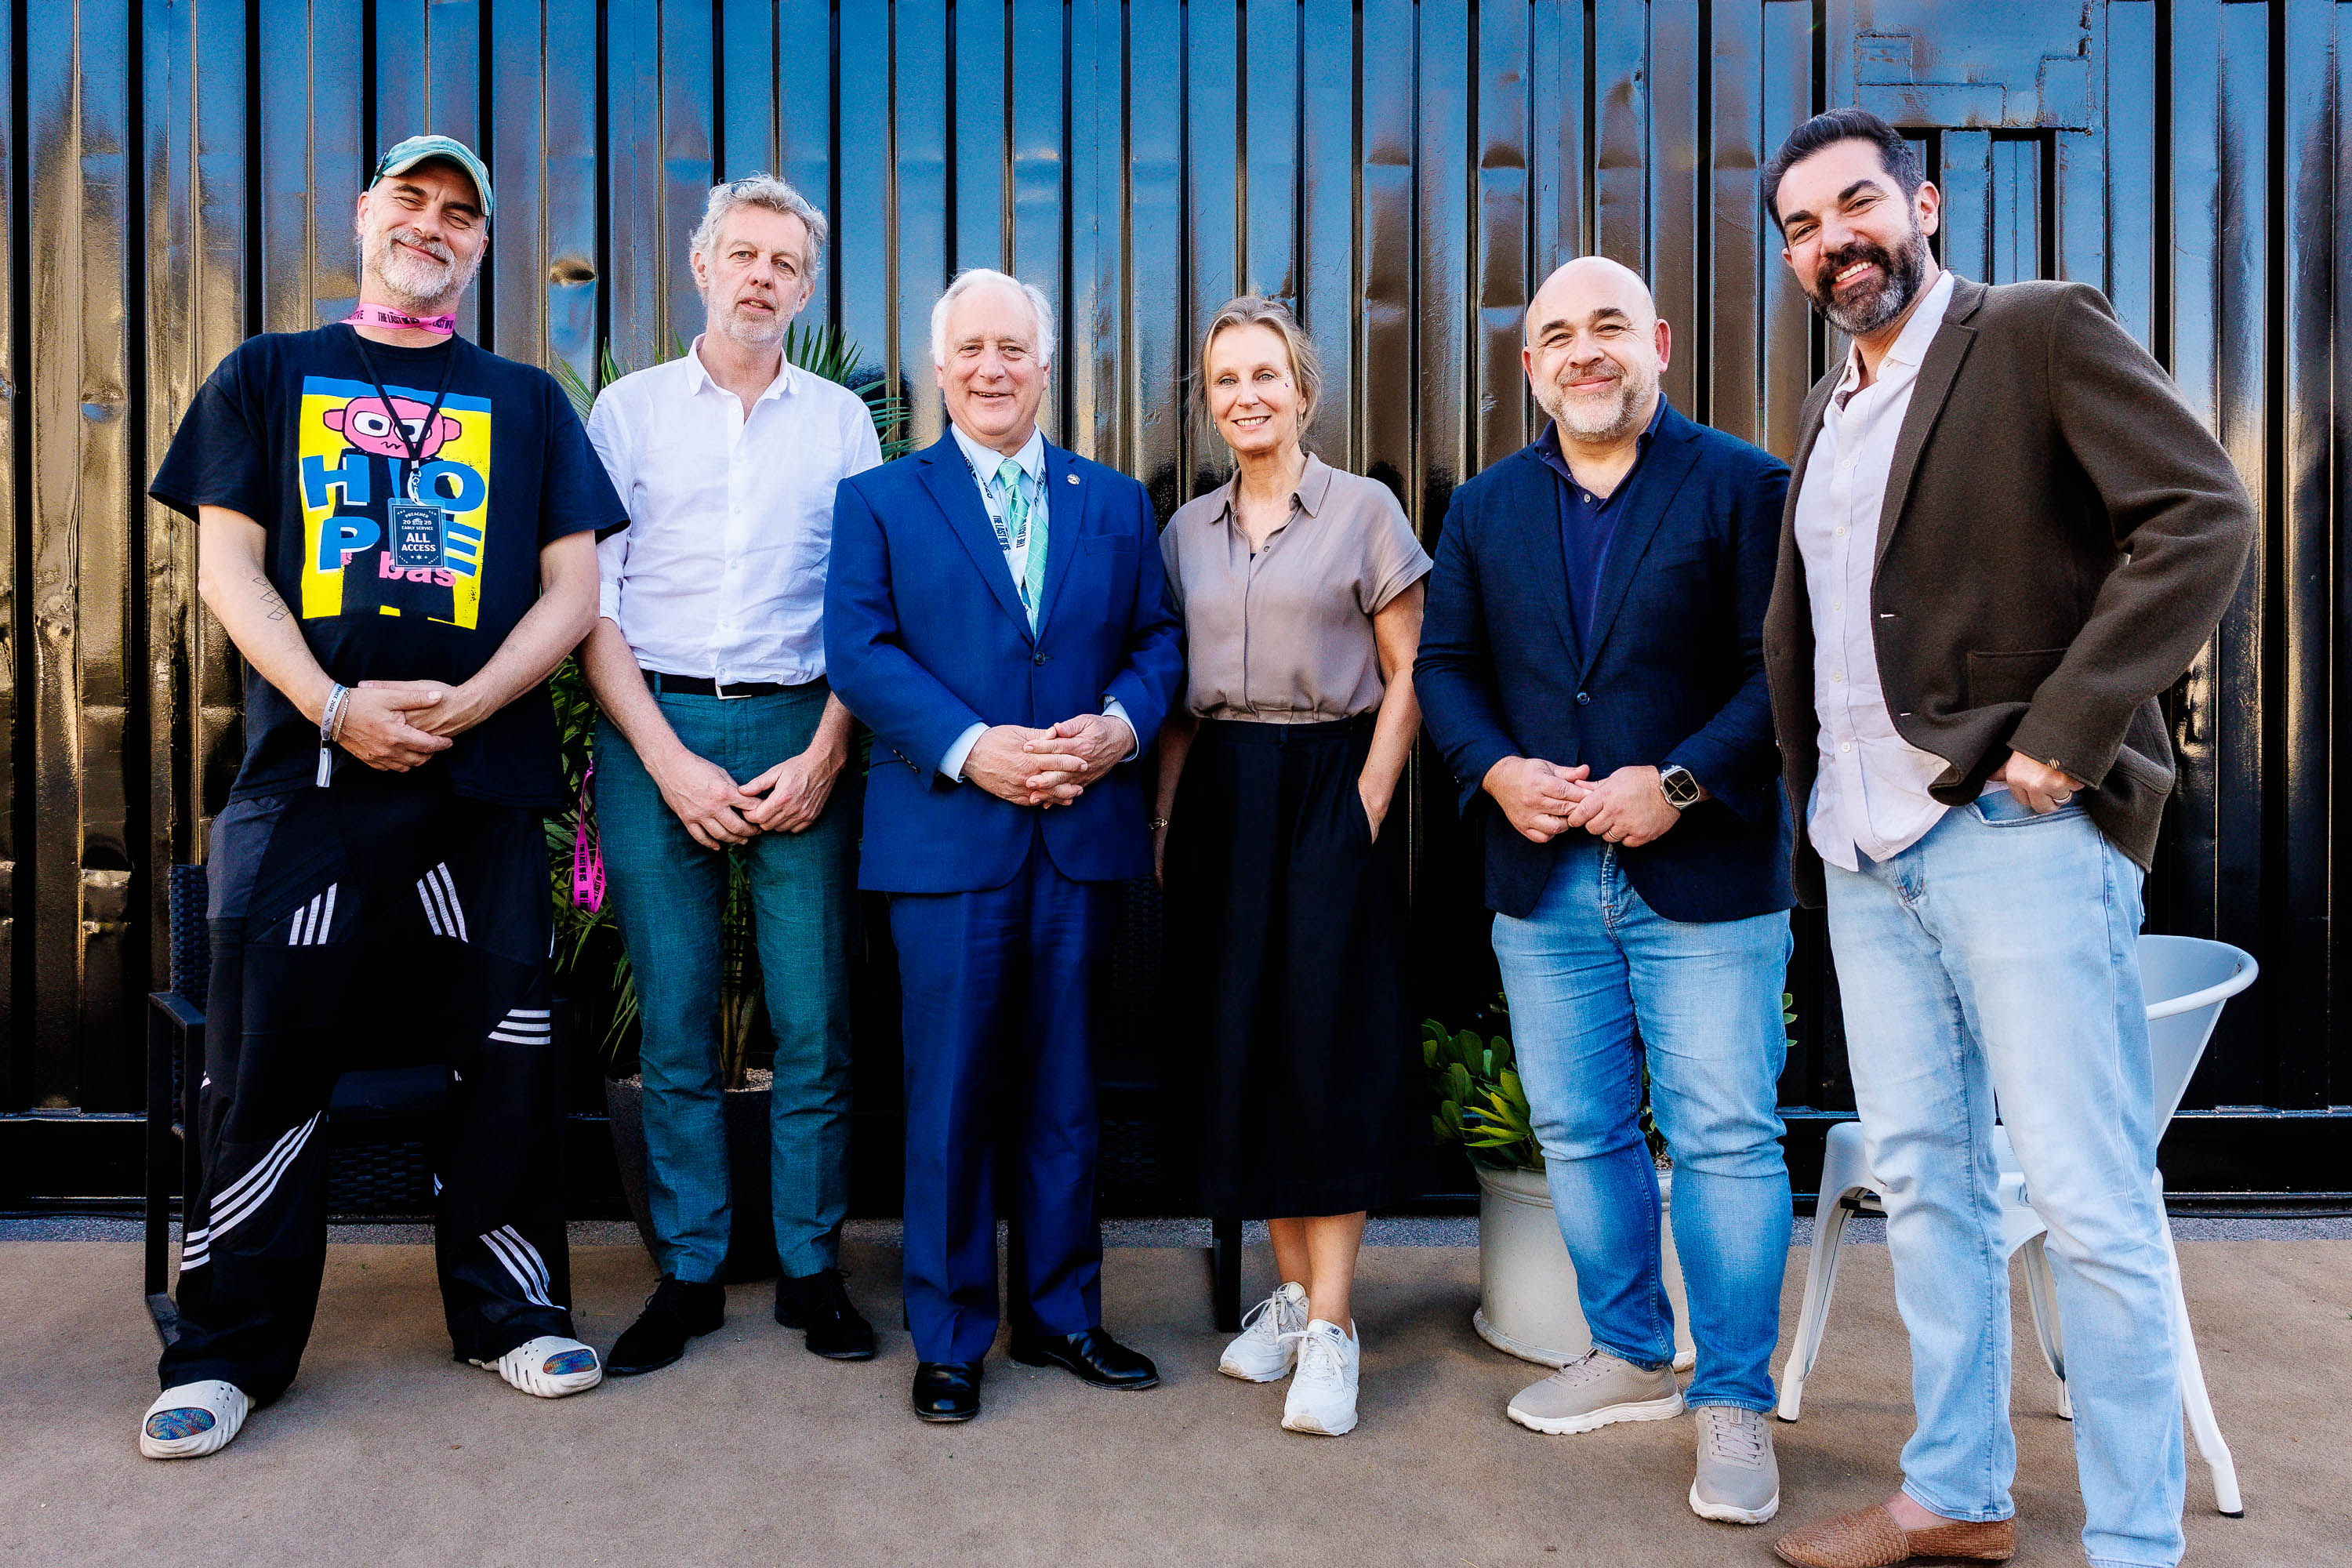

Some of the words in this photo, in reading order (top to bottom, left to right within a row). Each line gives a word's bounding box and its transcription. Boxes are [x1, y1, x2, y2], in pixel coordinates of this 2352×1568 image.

[377, 311, 388, 322] THE
[387, 314, 402, 324] LAST
[993, 515, 1003, 524] THE
[995, 524, 1007, 537] LAST
[405, 532, 430, 543] ALL
[1016, 537, 1025, 549] THE
